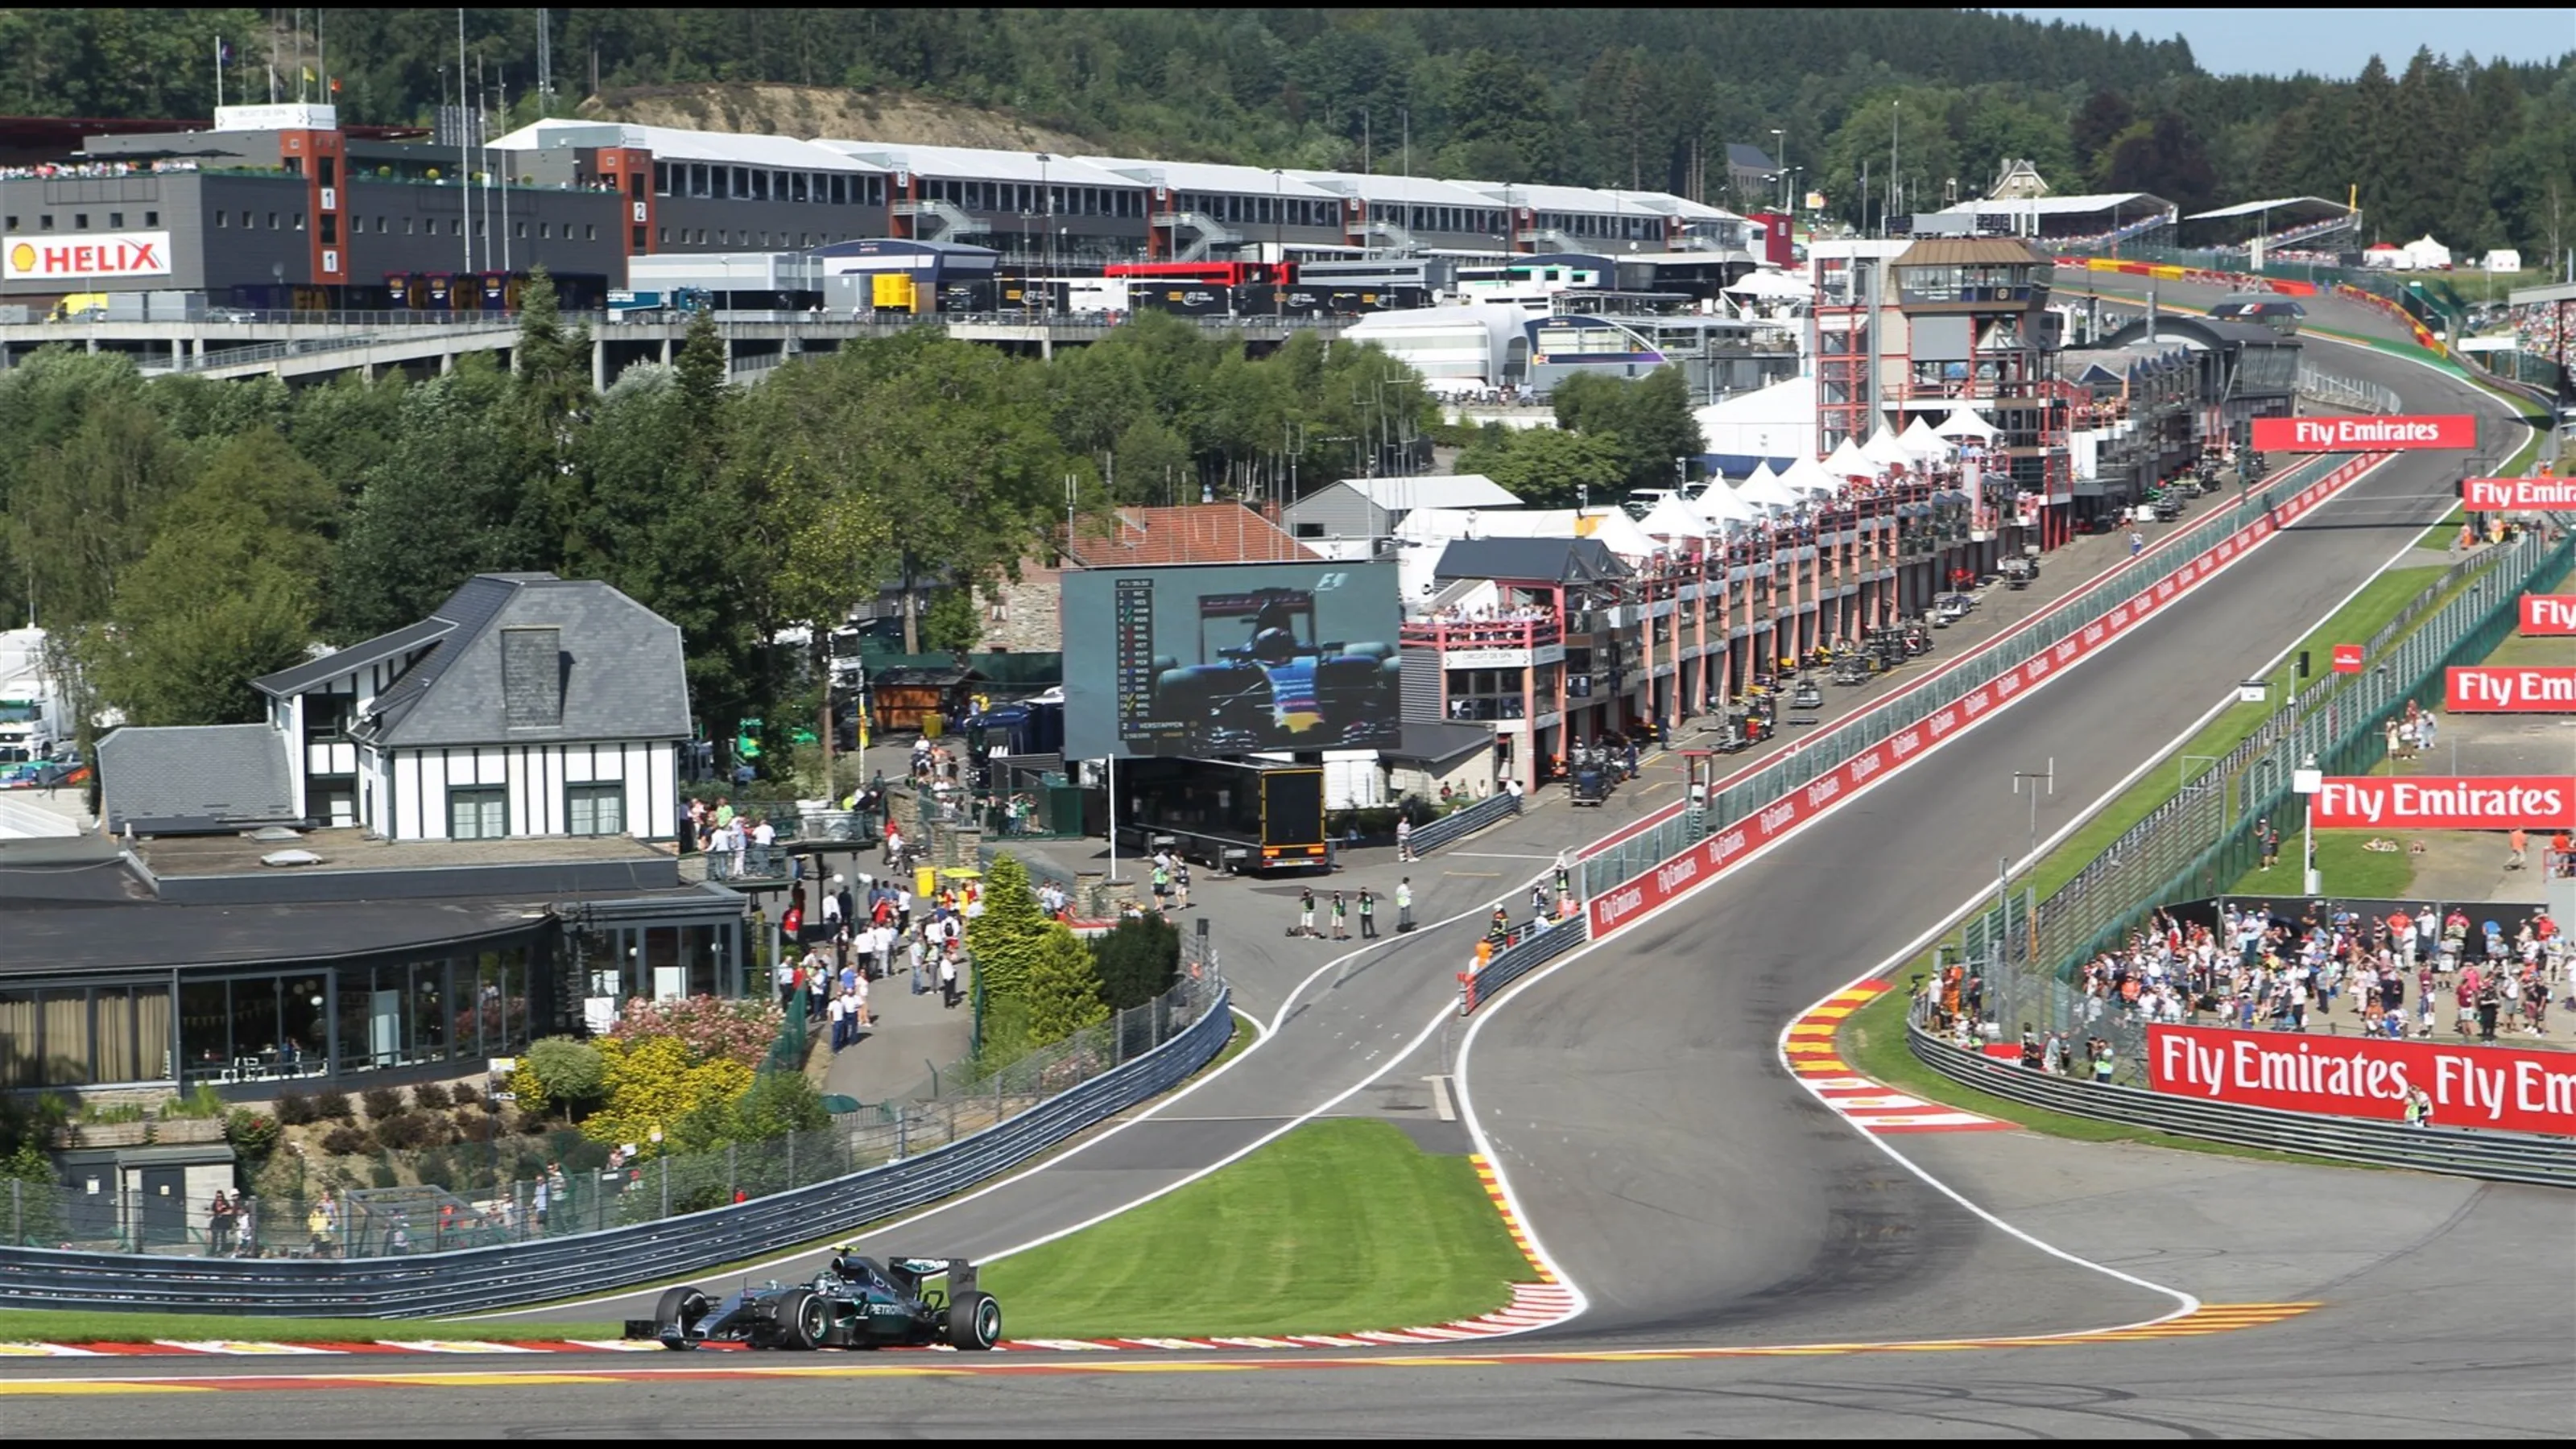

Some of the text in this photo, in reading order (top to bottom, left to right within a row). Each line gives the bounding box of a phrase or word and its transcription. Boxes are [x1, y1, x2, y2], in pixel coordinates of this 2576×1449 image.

[636, 204, 643, 220] 2
[44, 244, 159, 273] HELIX
[2296, 419, 2439, 446] Fly Emirates
[2472, 481, 2576, 507] Fly Emir
[2532, 600, 2576, 630] Fly
[2458, 672, 2576, 706] Fly Em
[2319, 781, 2562, 822] Fly Emirates
[2161, 1034, 2409, 1100] Fly Emirates
[2434, 1055, 2506, 1120] Fly
